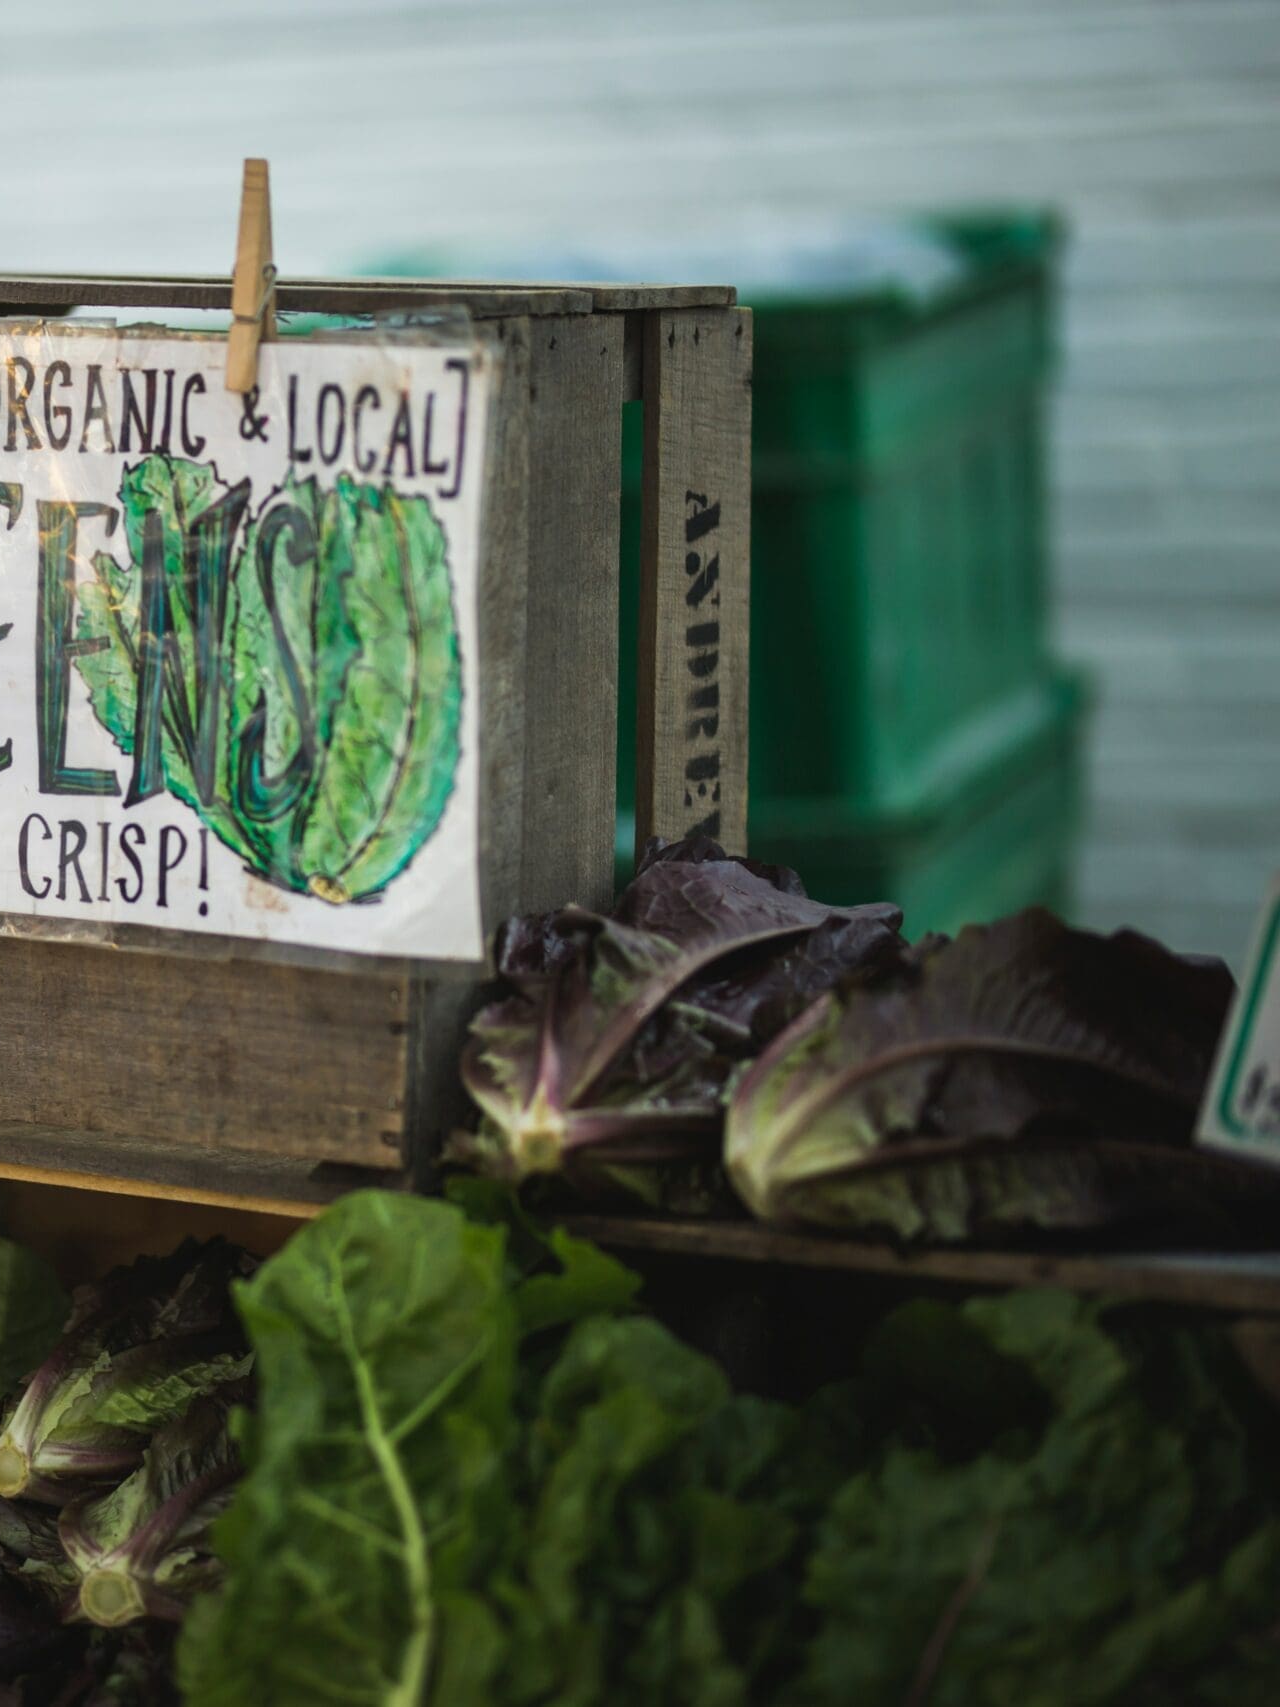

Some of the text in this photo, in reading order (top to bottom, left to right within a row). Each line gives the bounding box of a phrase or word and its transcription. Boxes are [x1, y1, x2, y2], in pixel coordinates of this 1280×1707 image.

[239, 384, 270, 443] &
[287, 358, 469, 499] LOCAL]
[19, 812, 210, 917] CRISP!
